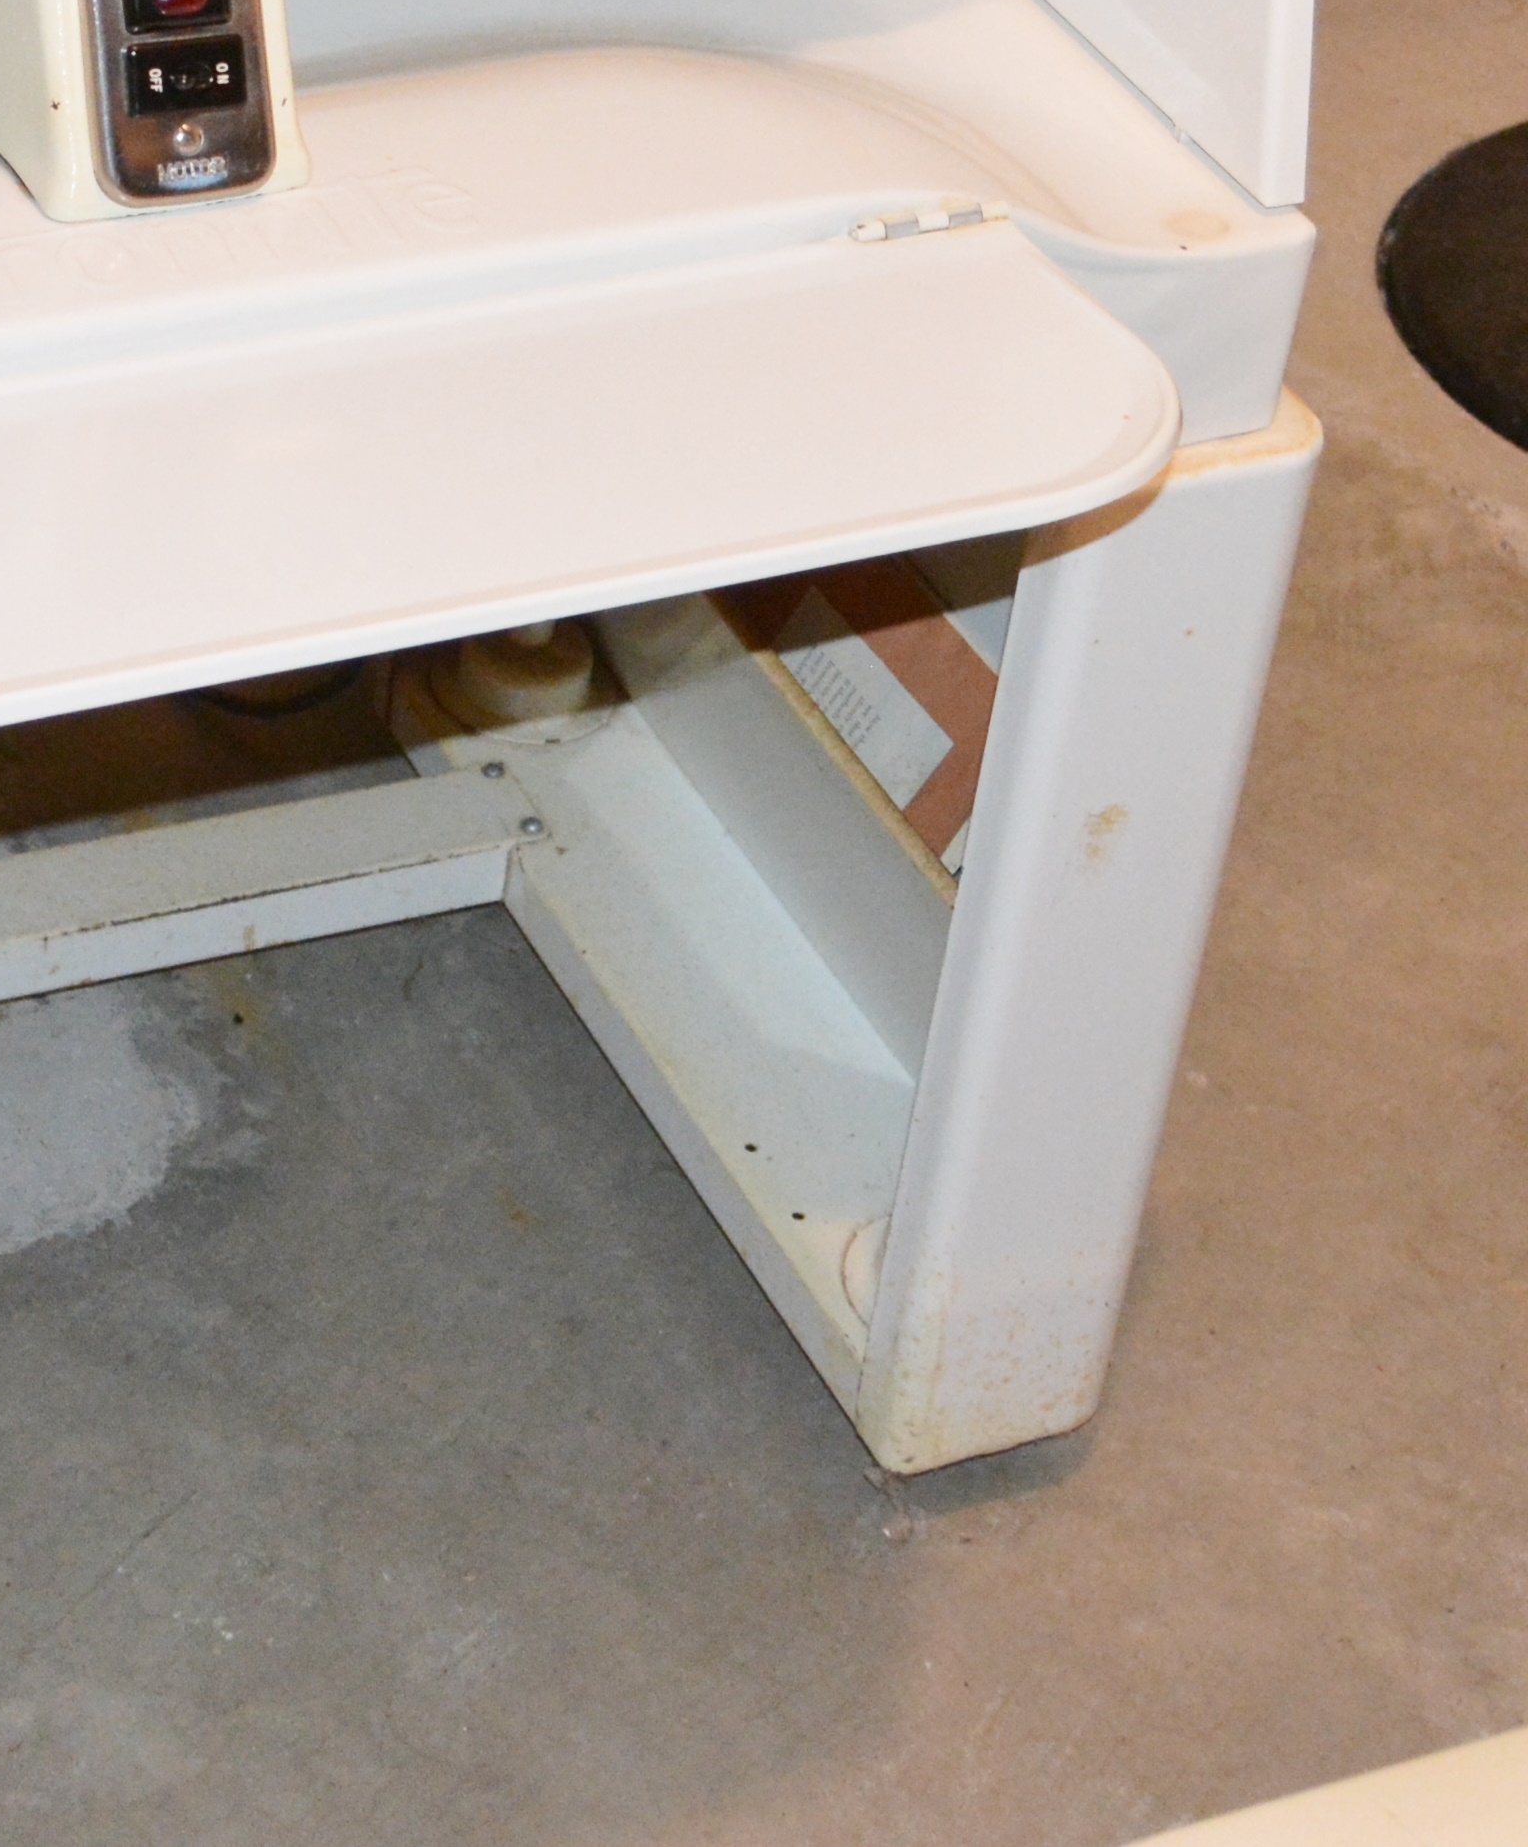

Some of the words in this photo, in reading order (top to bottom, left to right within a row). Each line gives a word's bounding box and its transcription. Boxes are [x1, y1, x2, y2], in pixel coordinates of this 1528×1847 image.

[148, 68, 164, 93] OFF
[215, 62, 230, 85] ON
[157, 156, 229, 185] MOTOR
